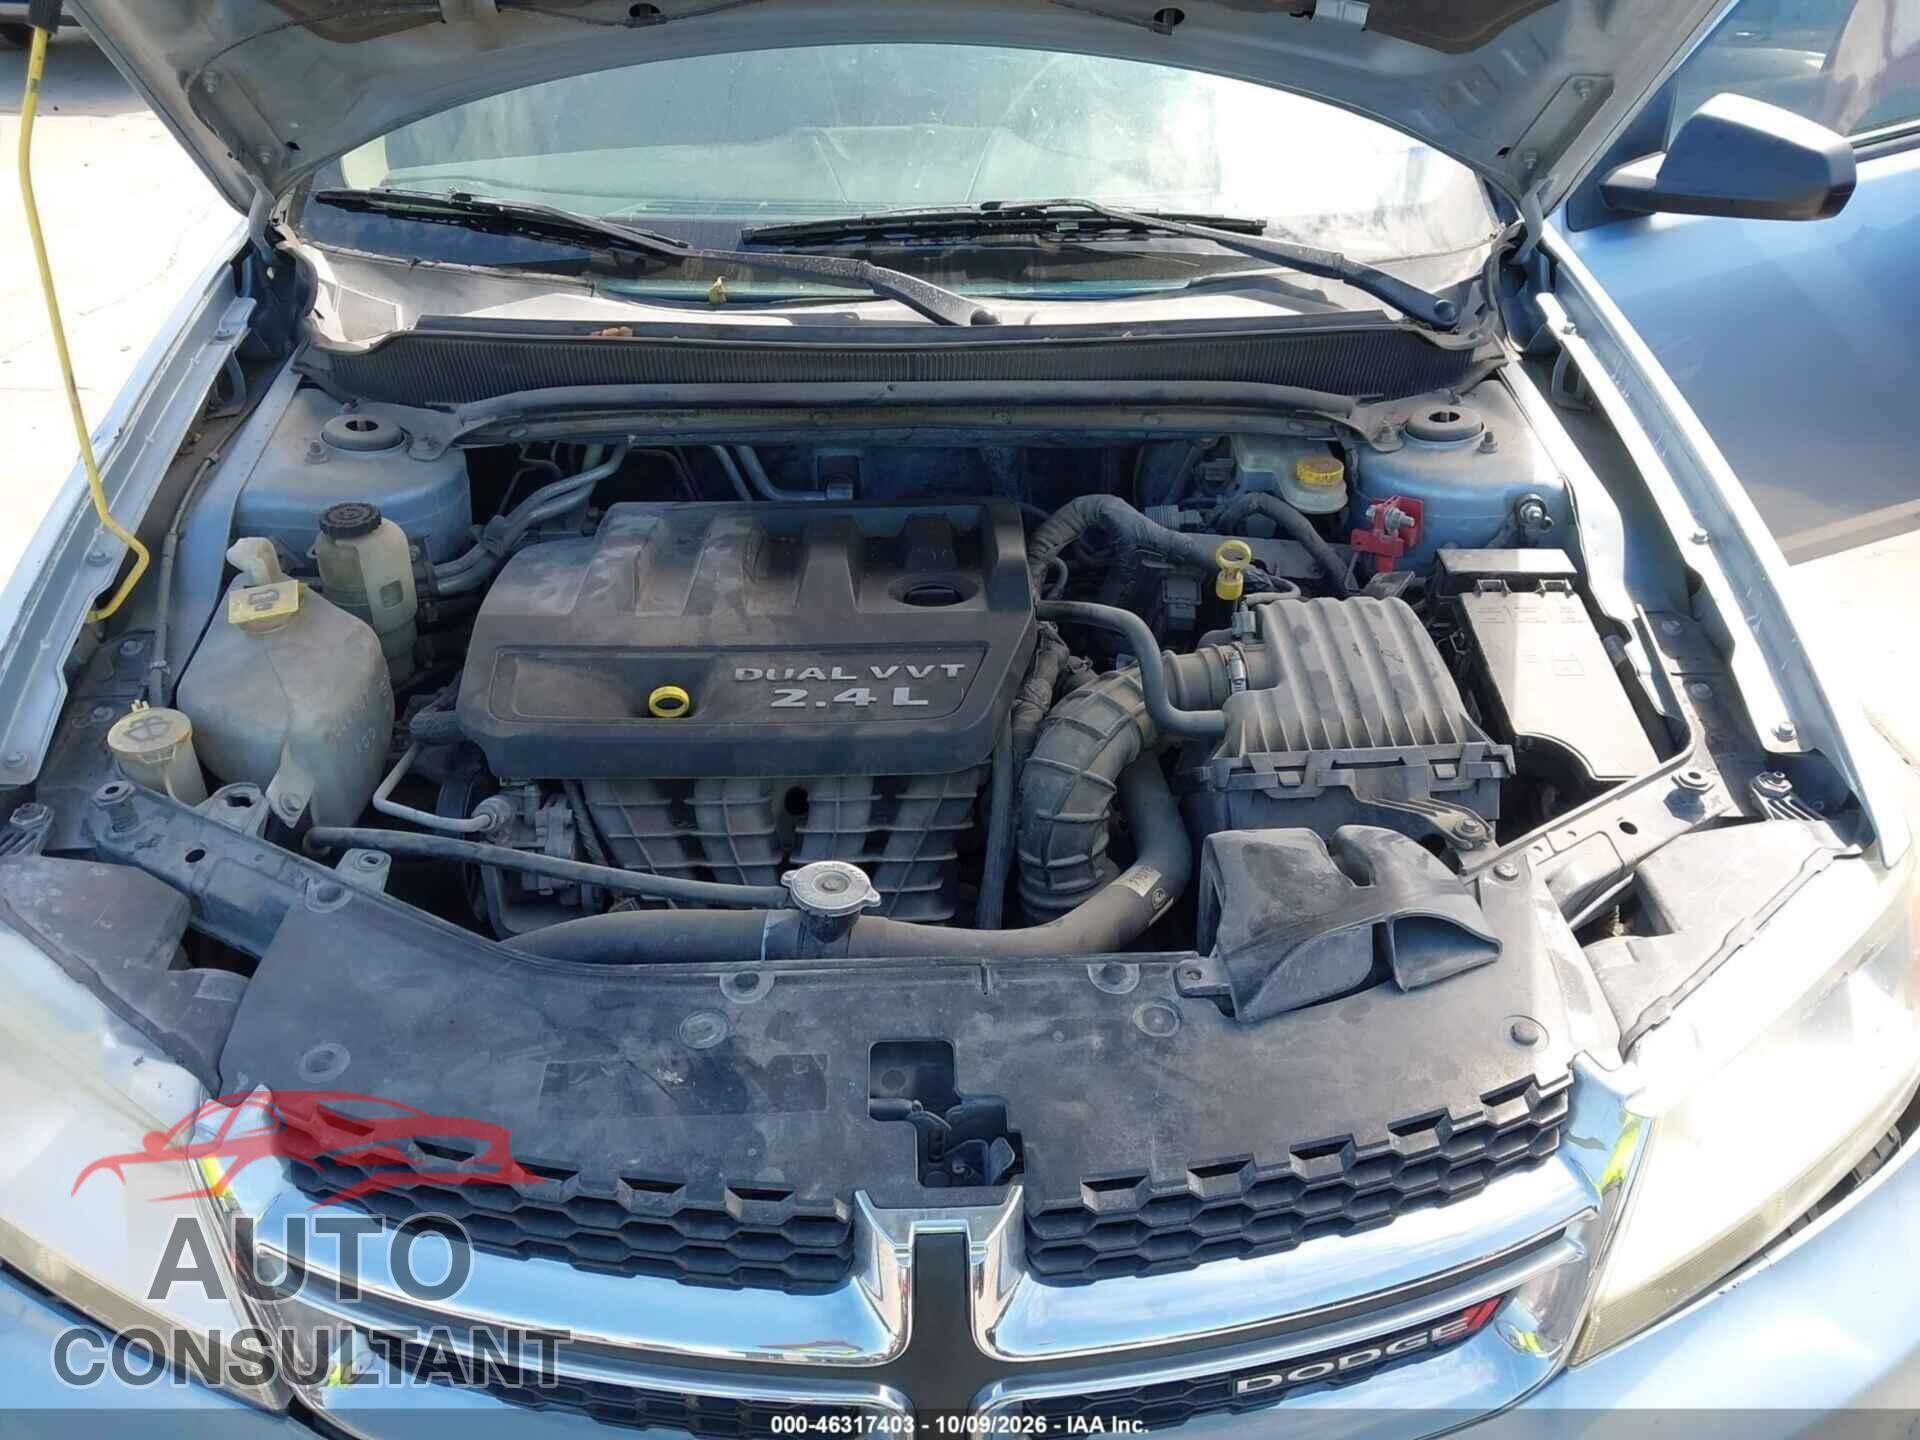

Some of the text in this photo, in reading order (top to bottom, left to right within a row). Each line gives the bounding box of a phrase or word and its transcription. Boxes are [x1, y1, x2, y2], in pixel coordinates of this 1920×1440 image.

[734, 663, 966, 681] DUAL VVT
[770, 686, 929, 708] 2.4 L
[1236, 1316, 1470, 1395] DODGE
